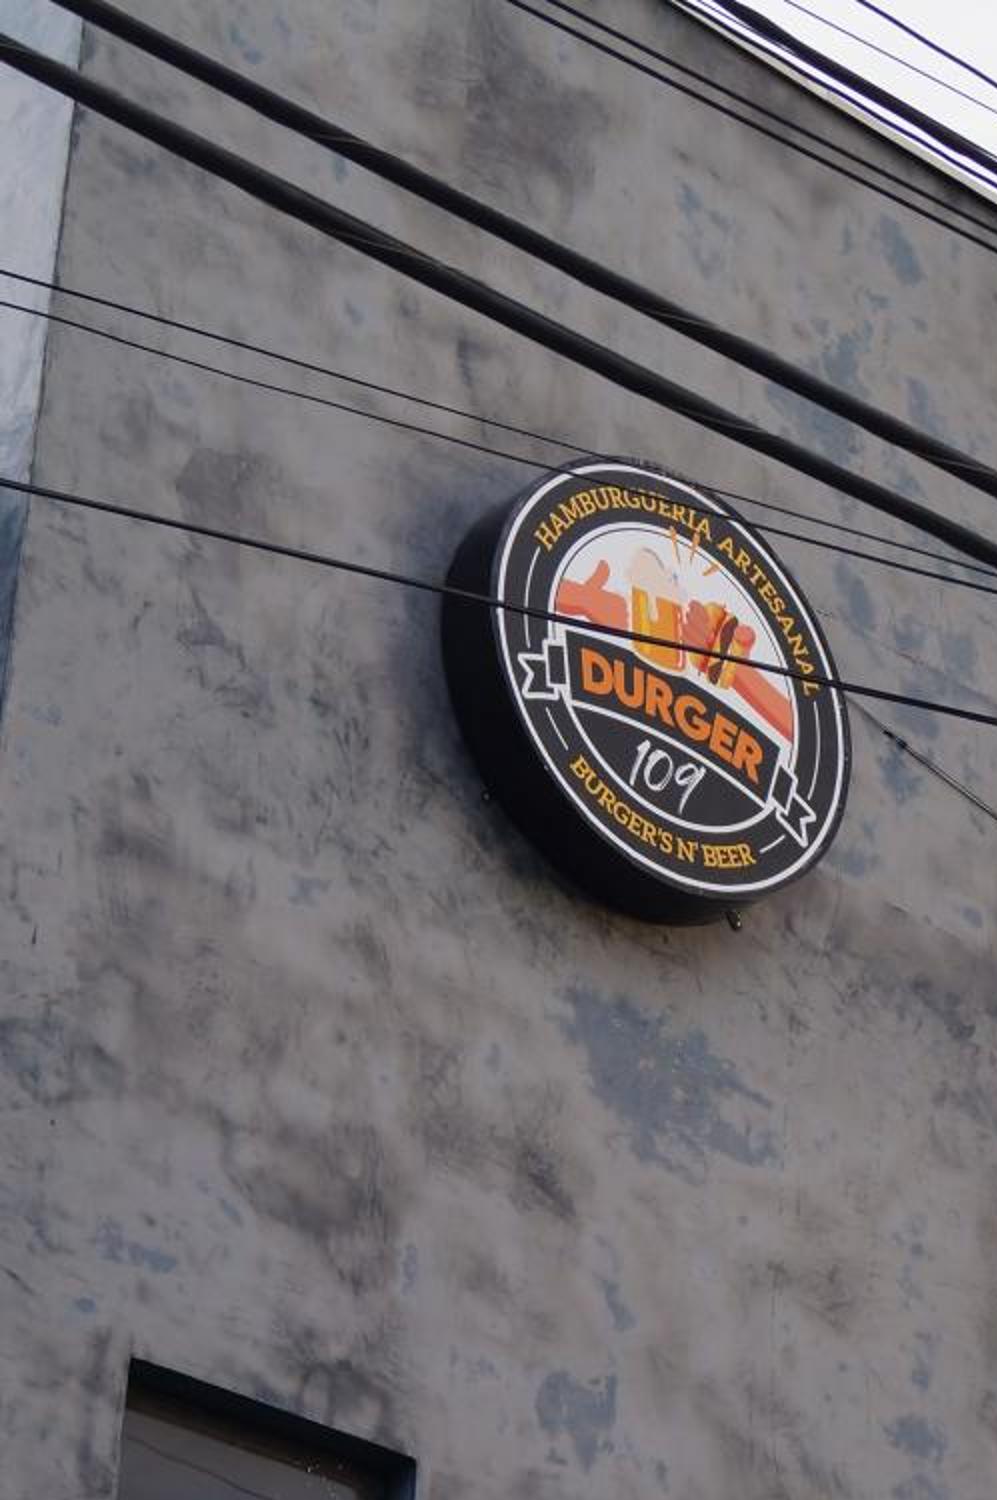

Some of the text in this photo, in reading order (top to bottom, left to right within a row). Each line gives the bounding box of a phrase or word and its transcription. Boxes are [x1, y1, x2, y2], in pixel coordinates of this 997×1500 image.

[535, 487, 821, 697] HAMBURGUERIA ARTESANAL
[579, 647, 764, 785] DURGER
[629, 740, 706, 814] 109
[569, 754, 674, 854] BURGER'S
[702, 842, 757, 869] BEER
